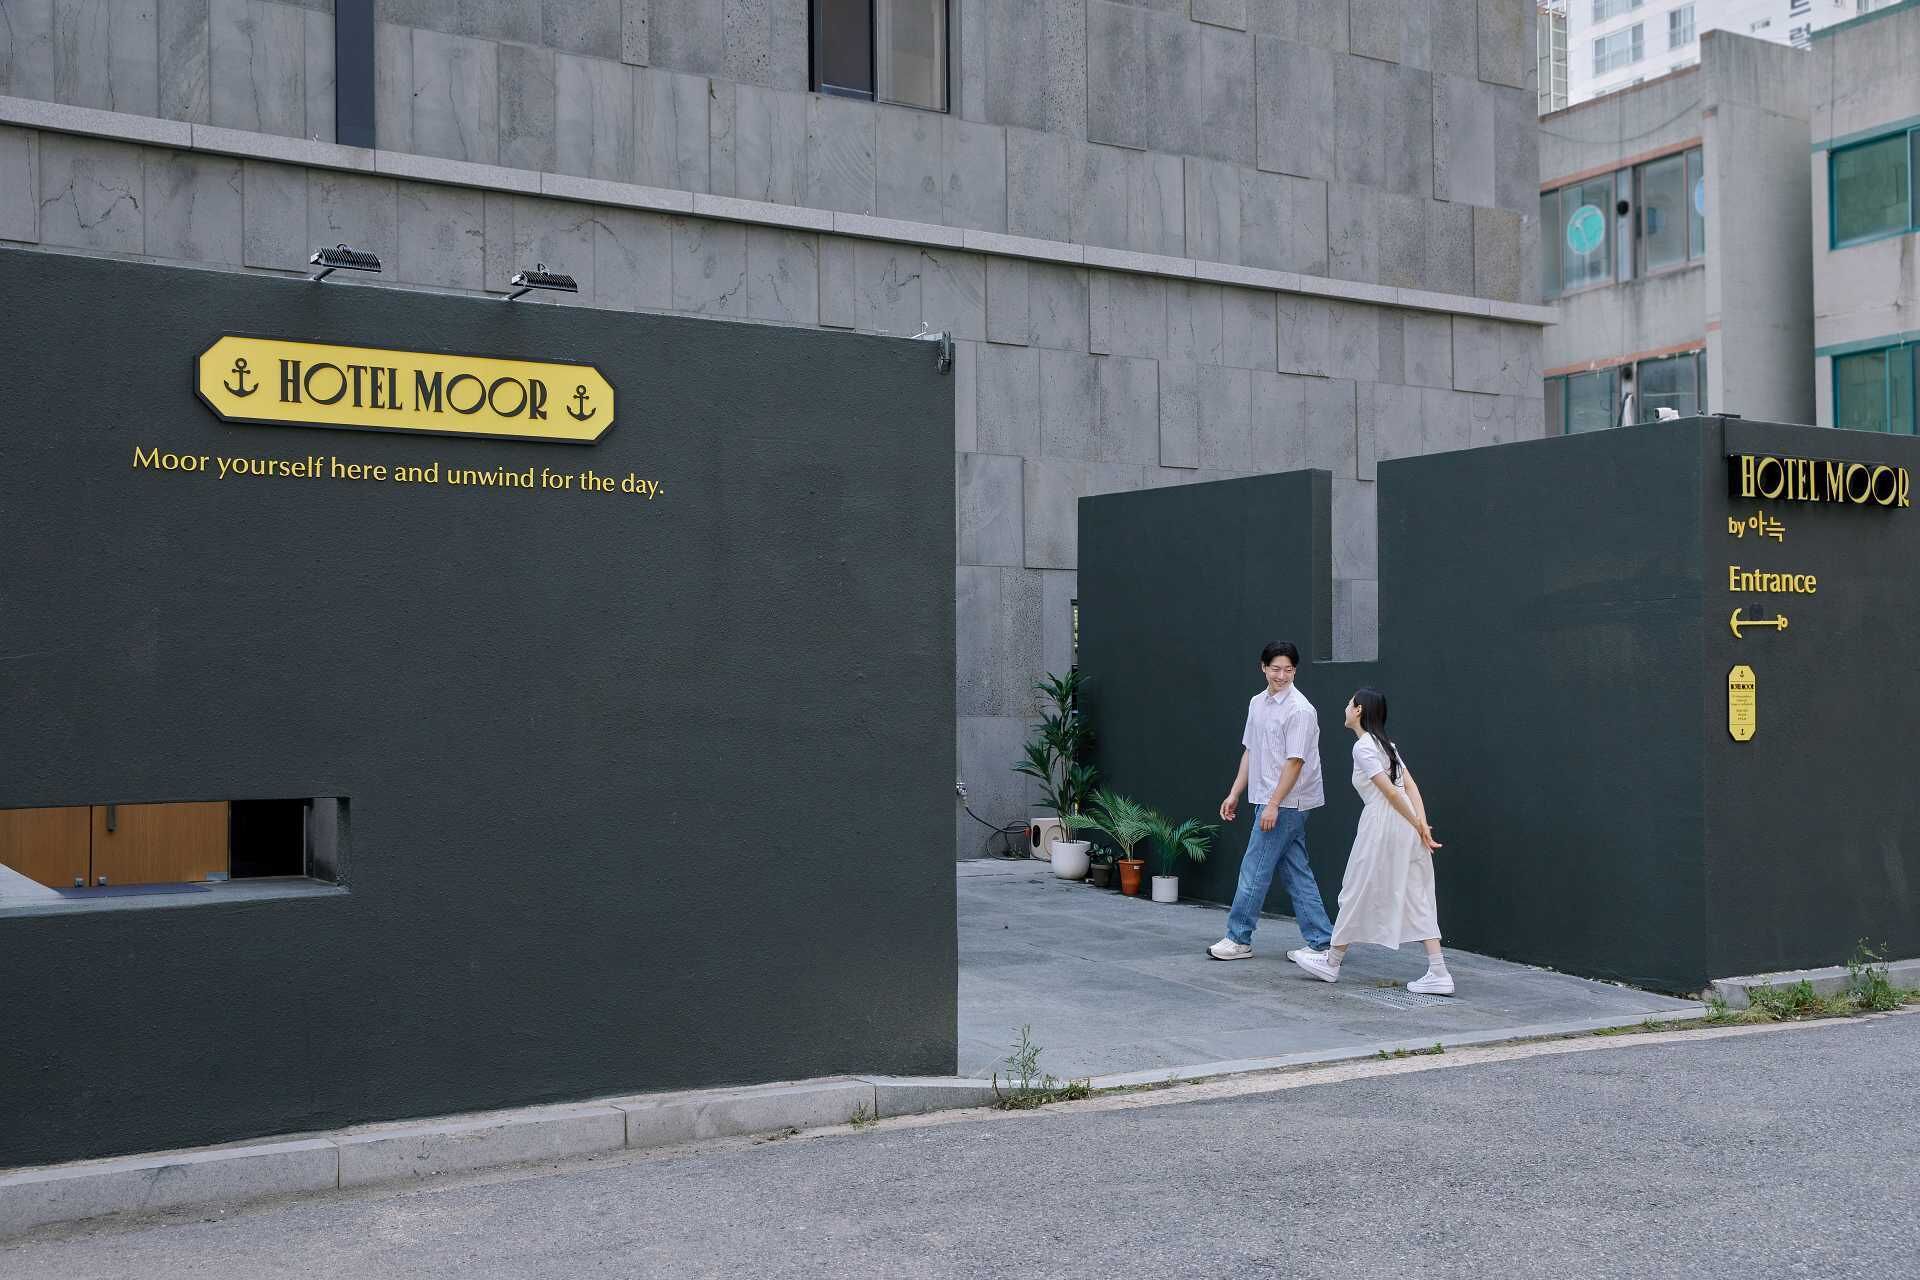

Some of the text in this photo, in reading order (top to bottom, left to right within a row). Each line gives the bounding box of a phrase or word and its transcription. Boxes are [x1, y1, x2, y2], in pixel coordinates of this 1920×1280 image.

[279, 359, 548, 421] HOTEL MOOR
[132, 446, 664, 499] Moor yourself here and unwind for the day.
[1741, 455, 1911, 507] HOTEL MOOR
[1727, 510, 1786, 543] by 아늑
[1728, 565, 1818, 594] Entrance
